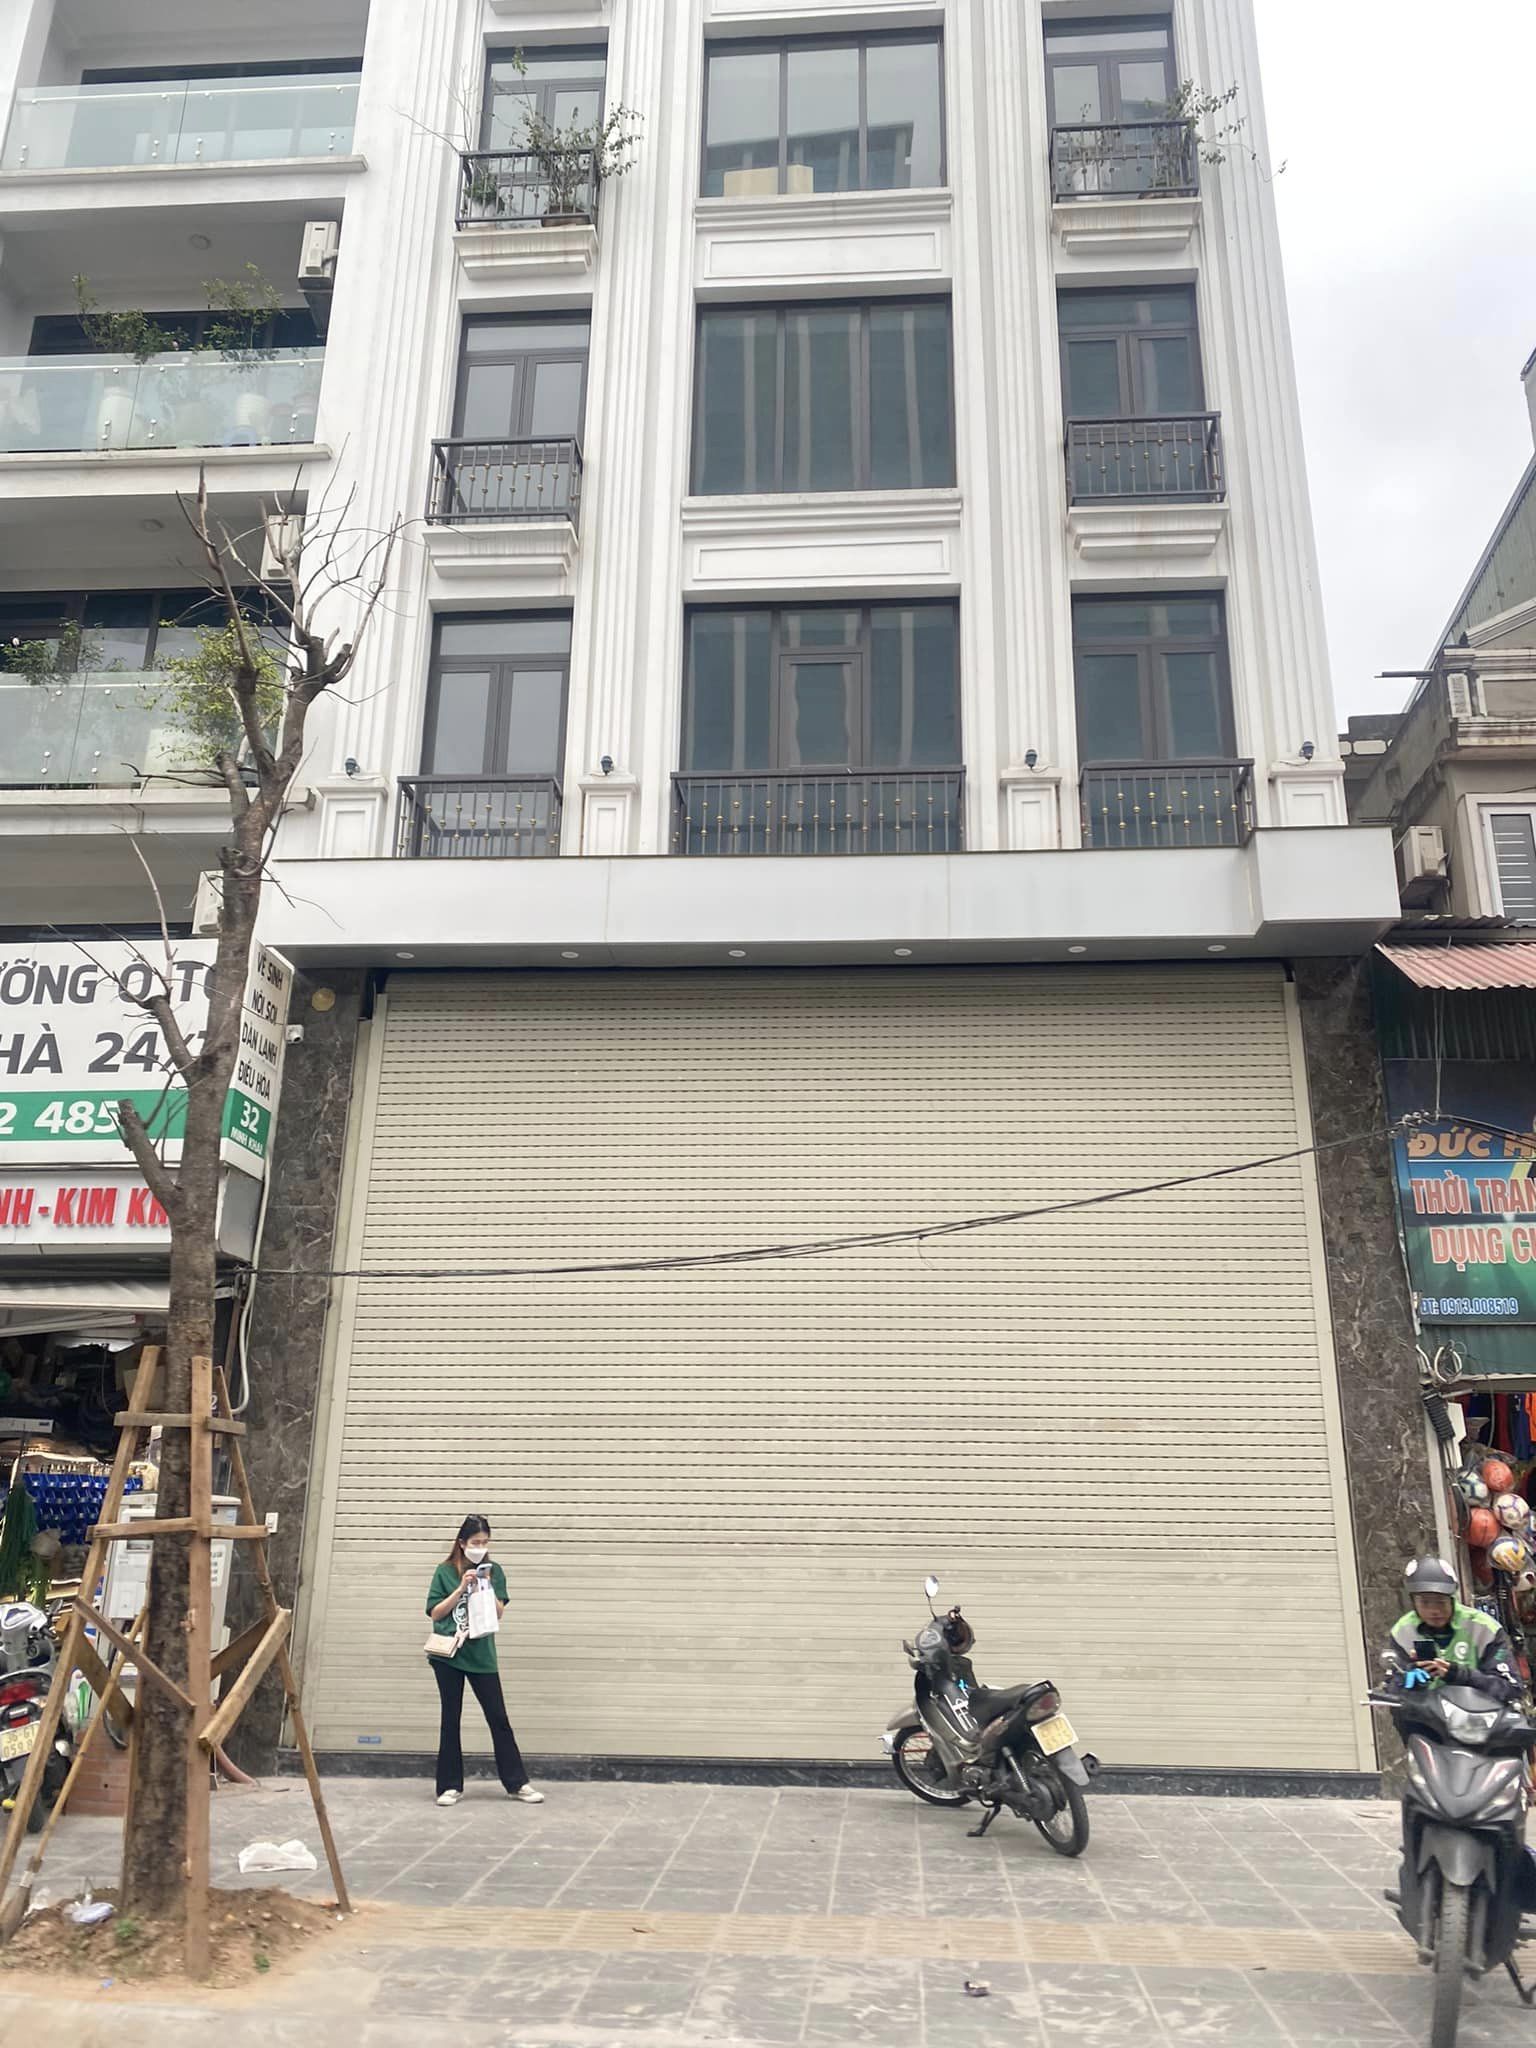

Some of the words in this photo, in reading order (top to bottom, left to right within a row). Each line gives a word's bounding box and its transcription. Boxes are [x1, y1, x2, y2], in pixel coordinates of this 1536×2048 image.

[267, 961, 283, 991] SINH
[240, 1100, 260, 1134] 32
[1407, 1125, 1493, 1158] ĐỨC
[1409, 1168, 1473, 1215] THỜI
[1428, 1226, 1507, 1272] DỤNG
[1440, 1296, 1519, 1316] 0913.008519
